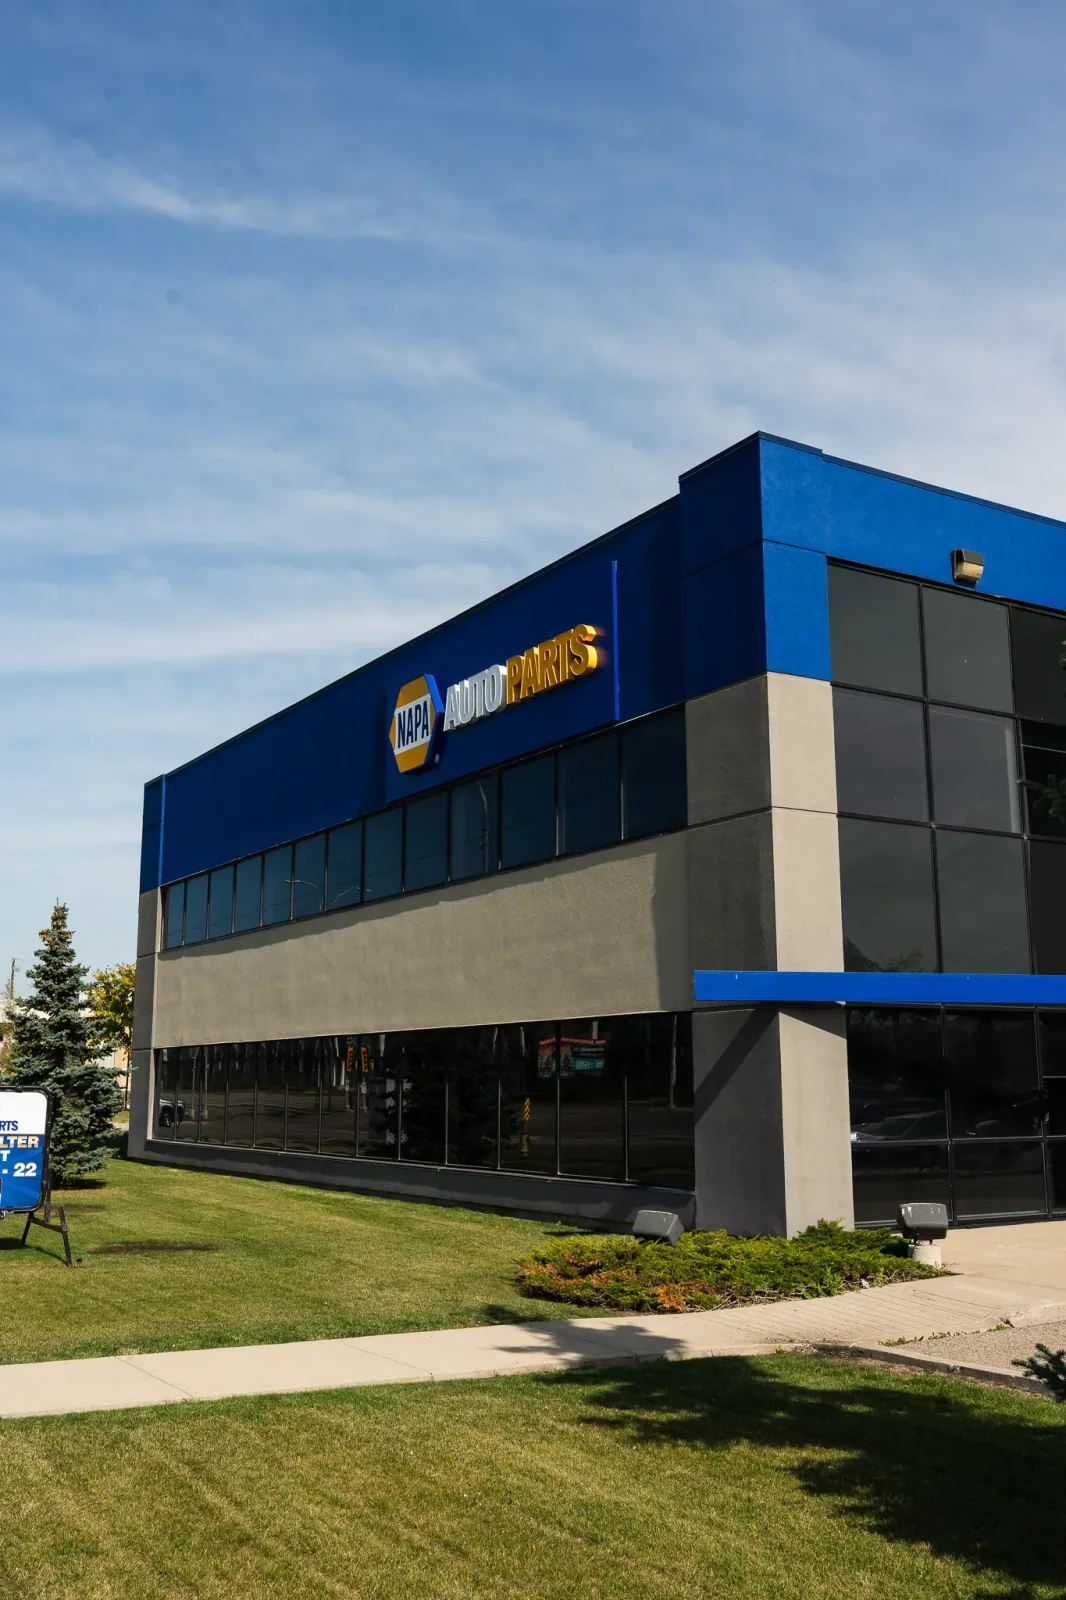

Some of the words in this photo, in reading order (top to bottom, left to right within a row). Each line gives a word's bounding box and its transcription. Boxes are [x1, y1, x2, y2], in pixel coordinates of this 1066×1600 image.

[397, 699, 430, 749] NAPA
[443, 664, 507, 731] AUTO
[506, 624, 598, 704] PARTS
[0, 1136, 39, 1148] LTER
[13, 1162, 37, 1177] 22
